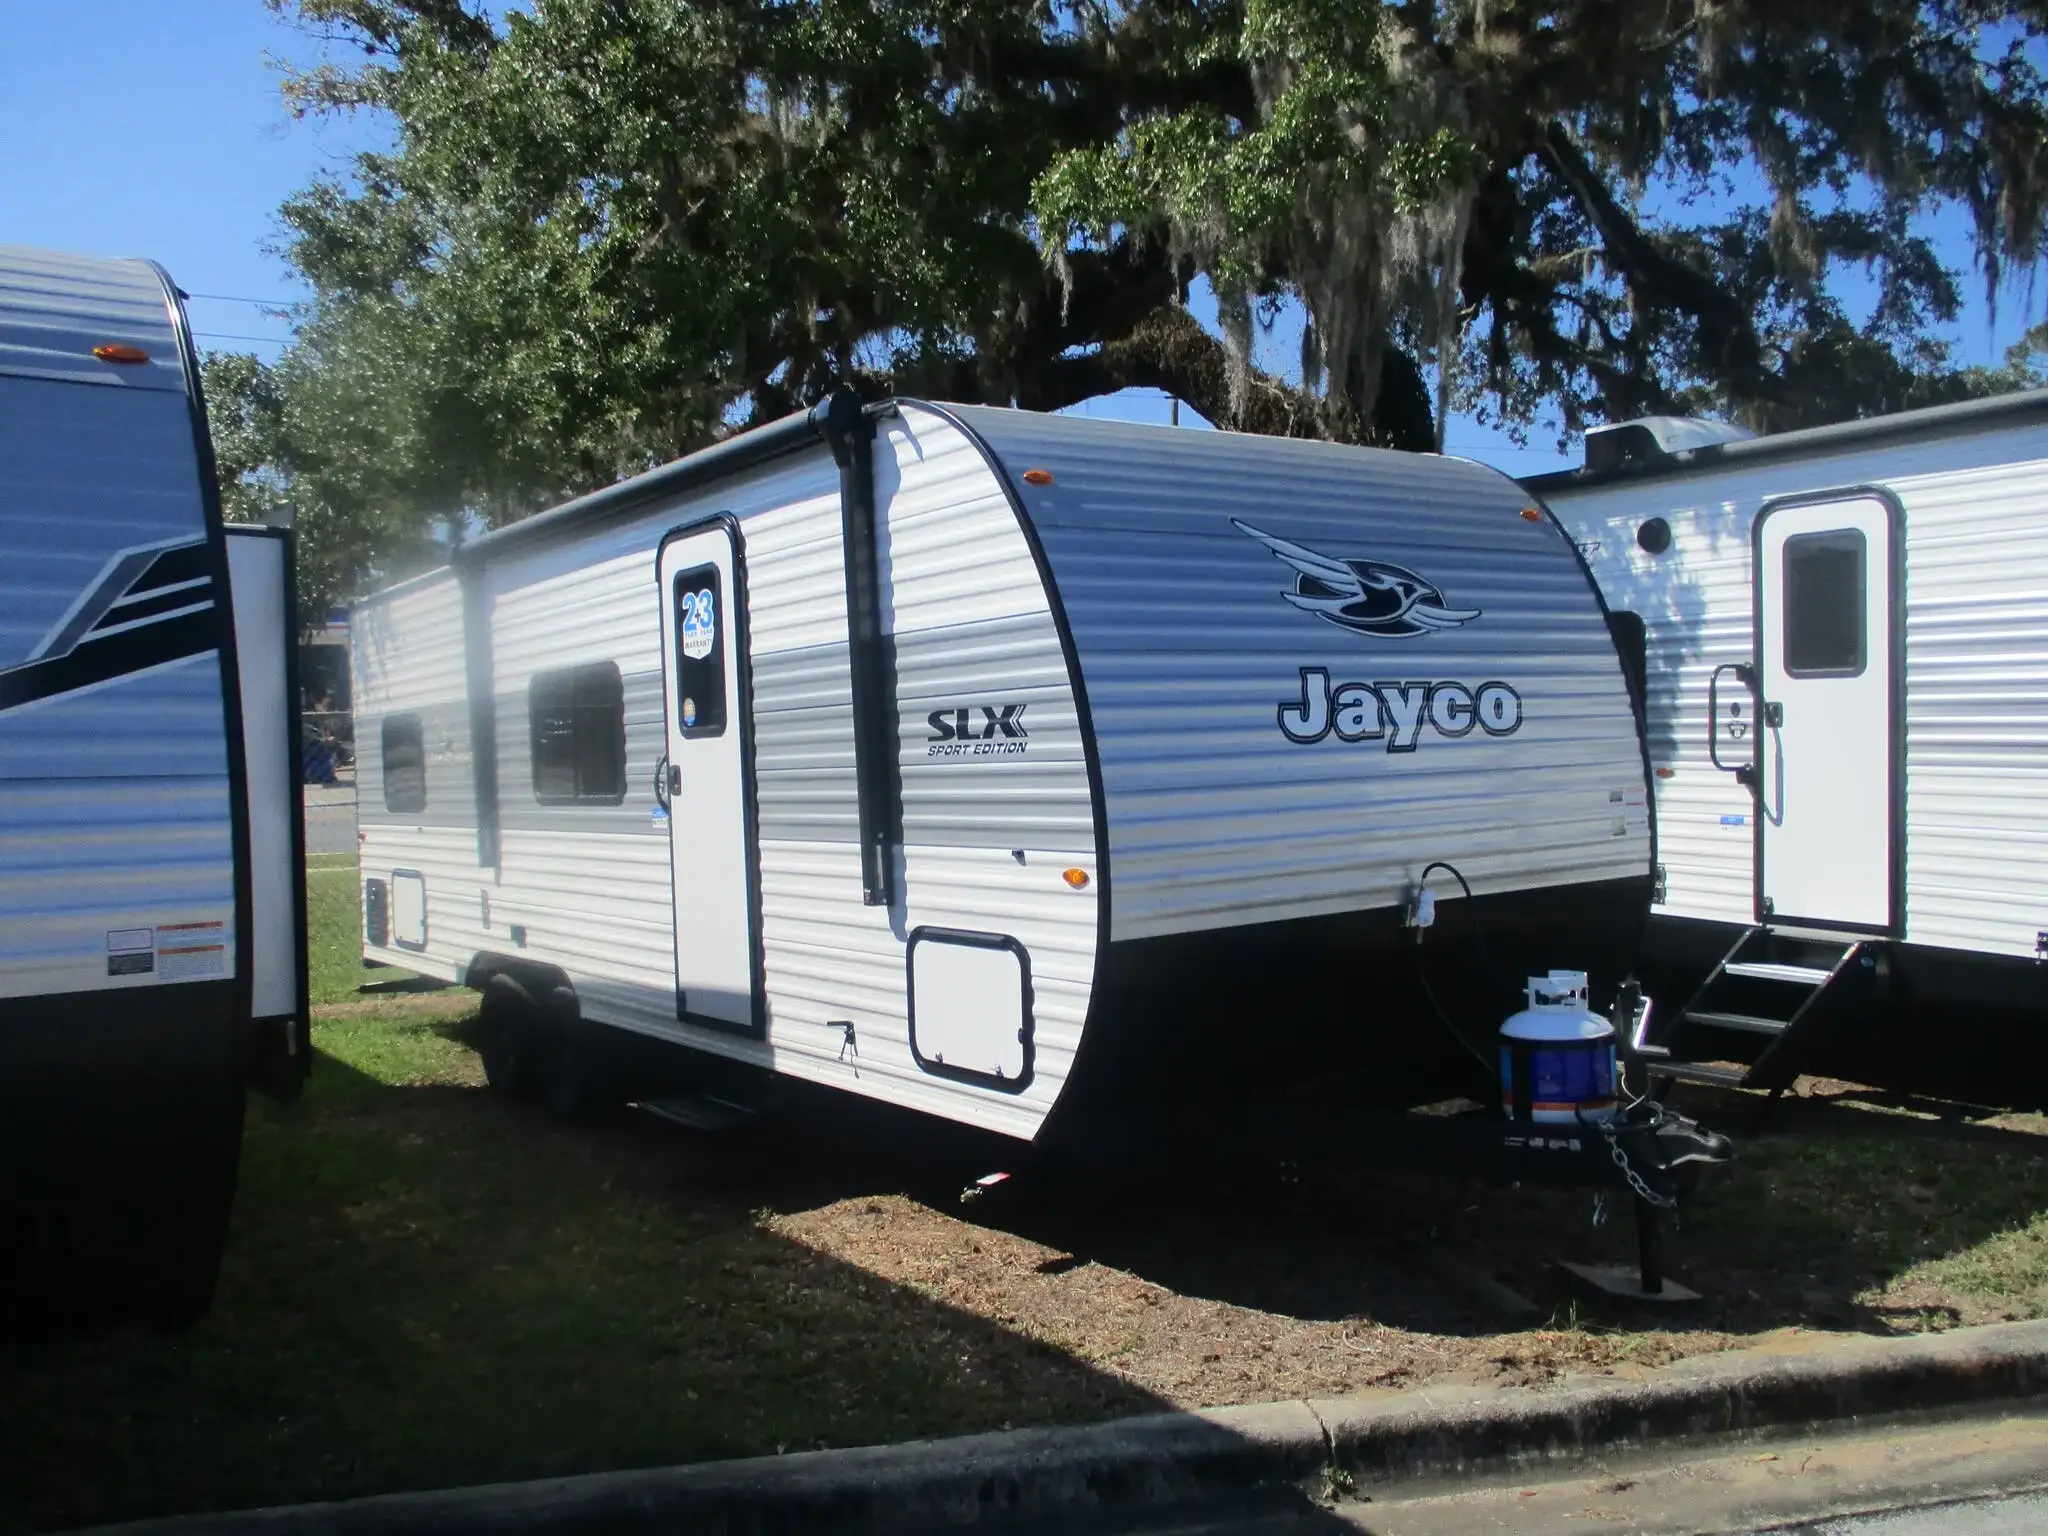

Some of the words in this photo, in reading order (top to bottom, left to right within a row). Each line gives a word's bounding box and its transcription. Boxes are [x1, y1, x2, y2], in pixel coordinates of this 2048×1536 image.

[927, 703, 1028, 742] SLX
[1277, 665, 1523, 753] Jayco
[927, 744, 970, 756] SPORT
[973, 741, 1028, 755] EDITION
